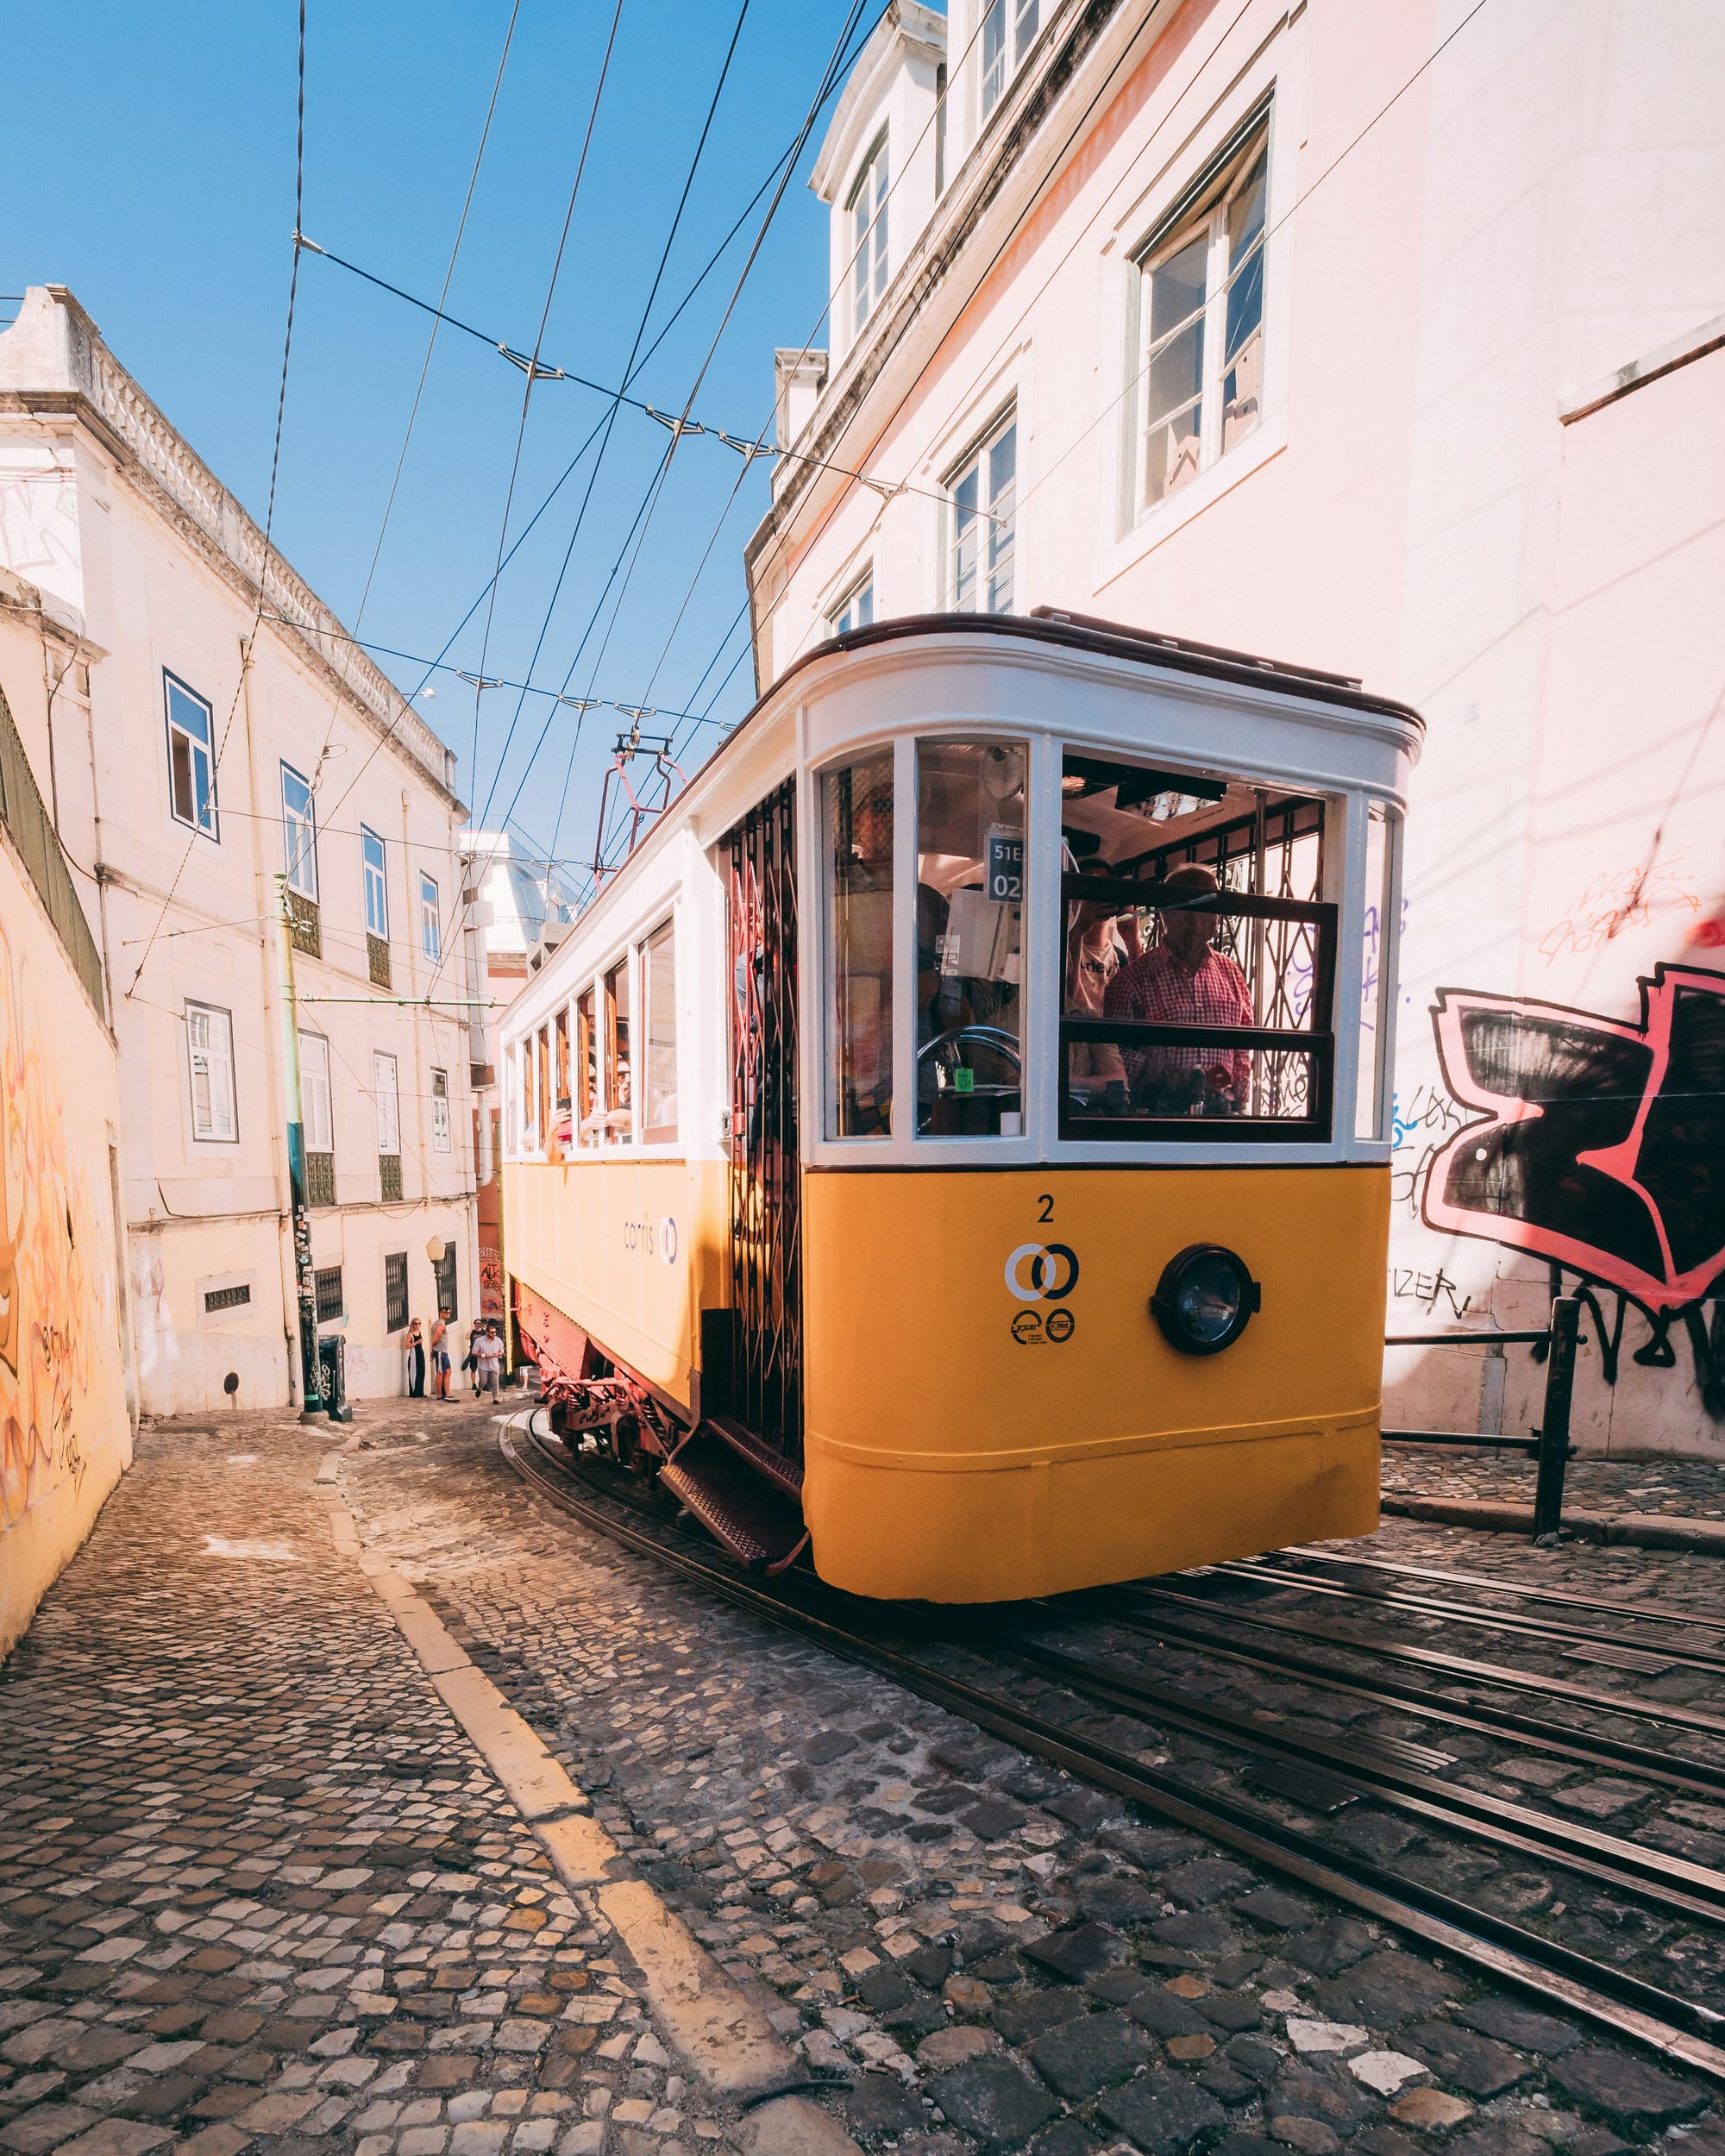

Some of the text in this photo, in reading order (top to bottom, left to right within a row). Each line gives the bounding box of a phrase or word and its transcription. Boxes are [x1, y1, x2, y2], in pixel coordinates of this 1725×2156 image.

[994, 845, 1022, 861] 51E
[994, 874, 1021, 897] 02
[1038, 1194, 1054, 1223] 2
[624, 1212, 654, 1256] carris
